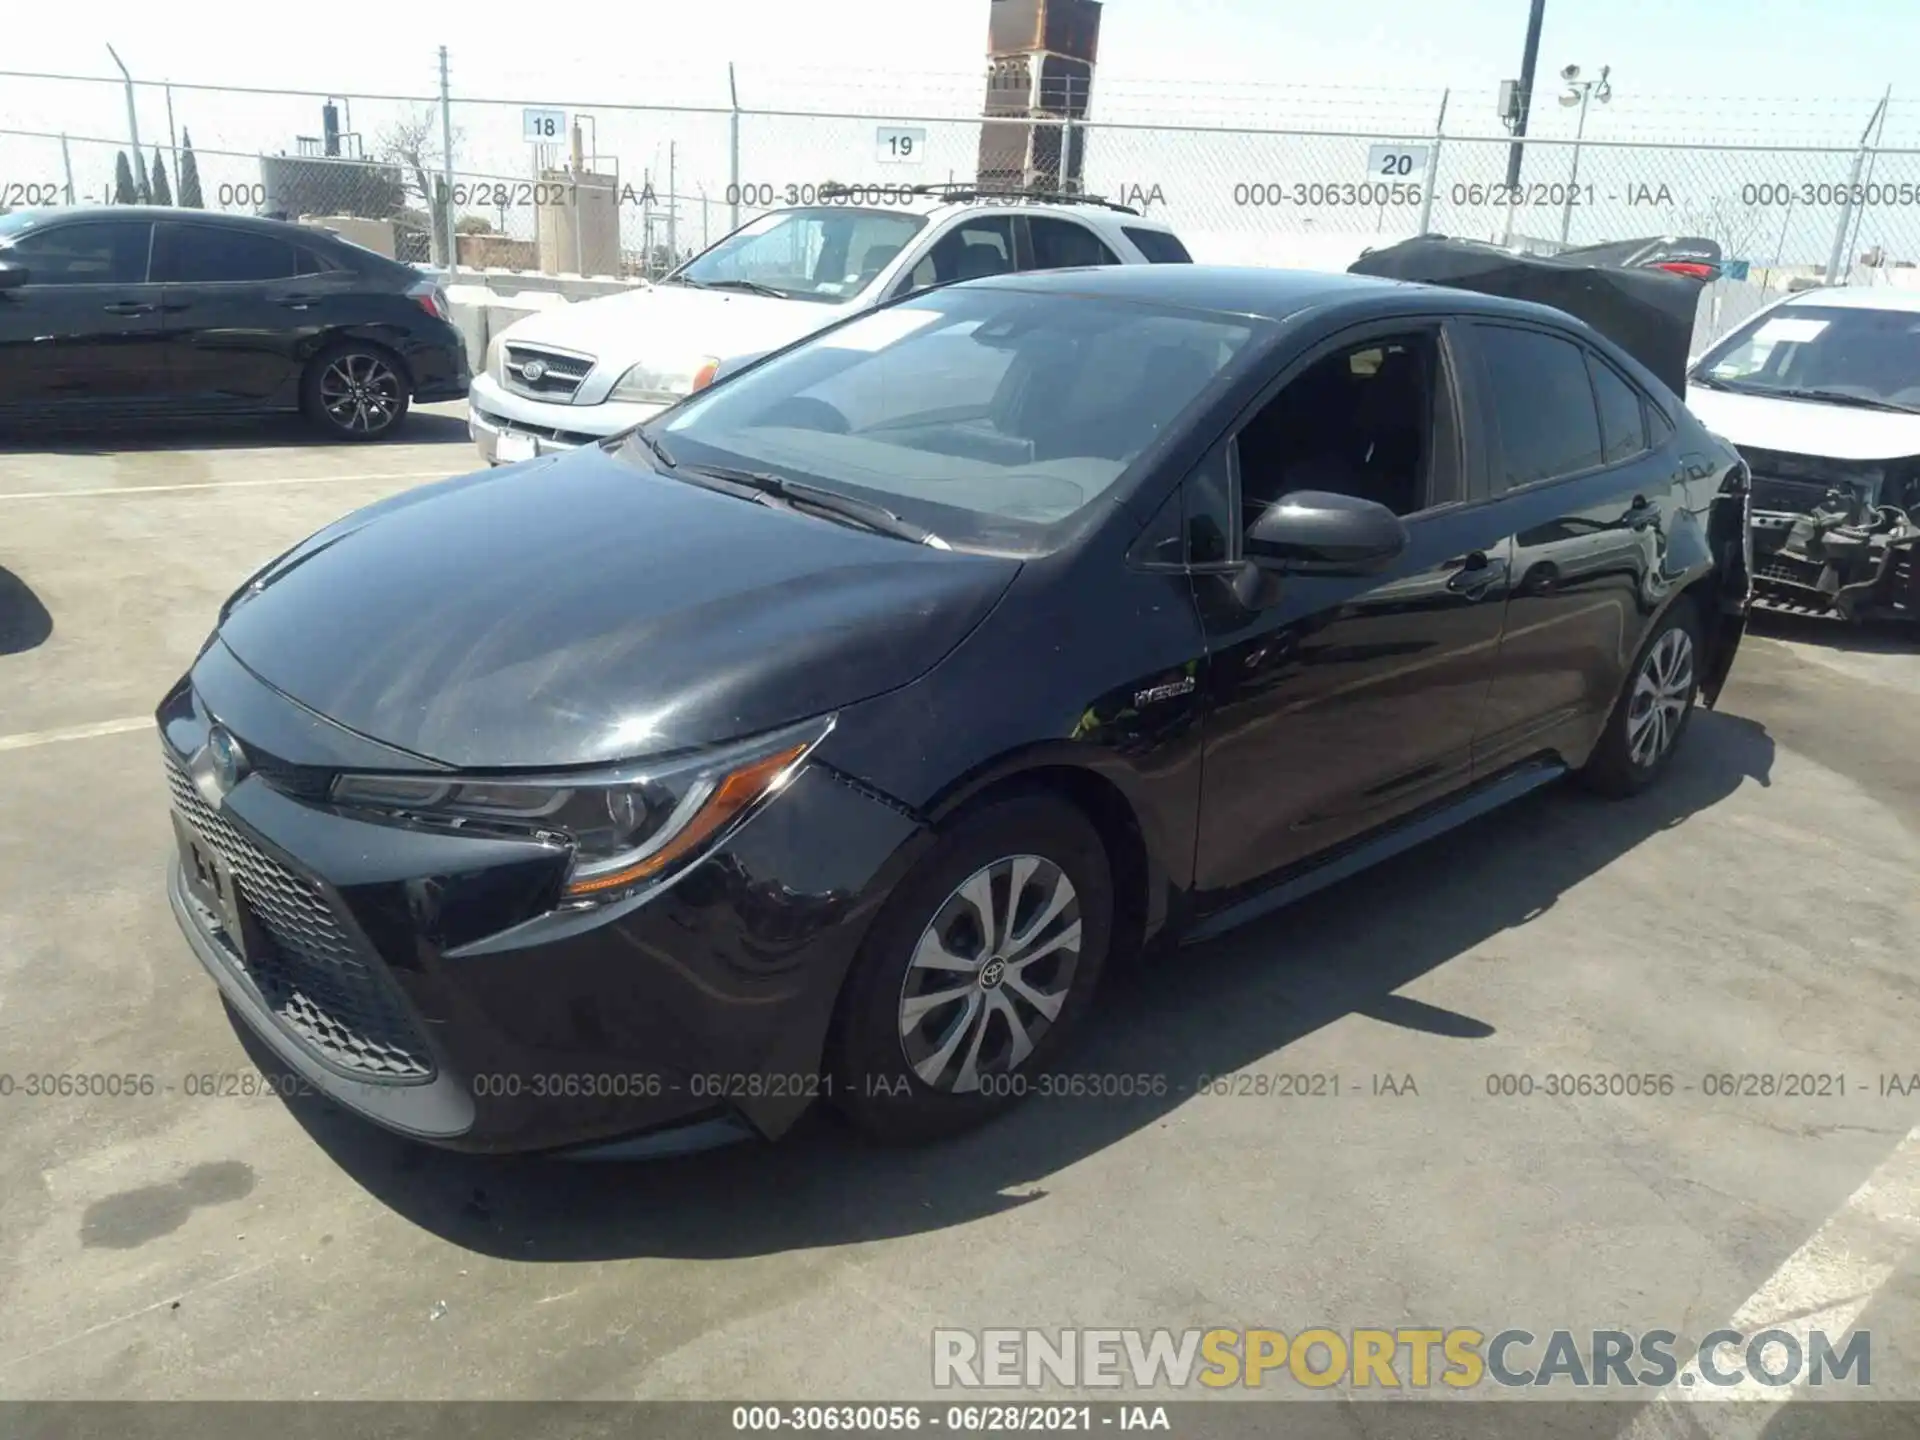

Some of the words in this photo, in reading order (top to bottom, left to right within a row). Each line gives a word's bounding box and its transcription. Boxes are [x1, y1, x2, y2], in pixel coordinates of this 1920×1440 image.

[534, 118, 555, 136] 18
[889, 136, 912, 156] 19
[1381, 154, 1412, 175] 20
